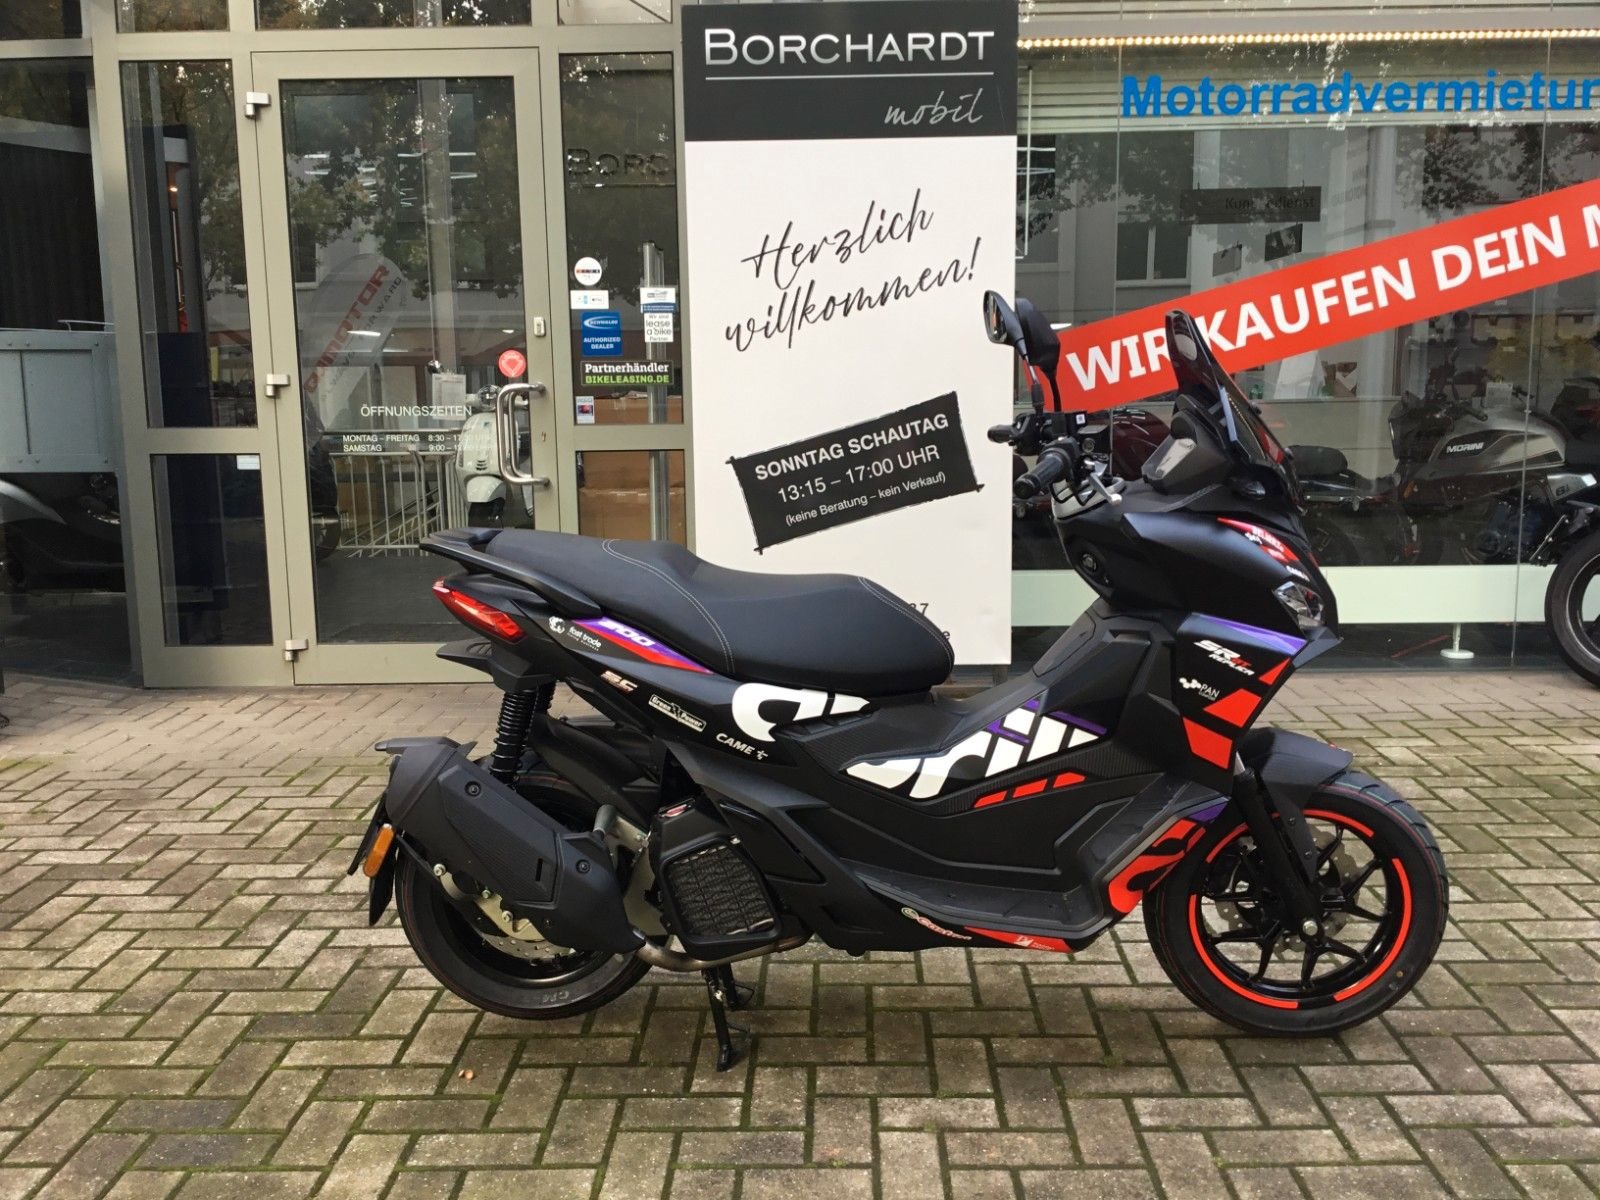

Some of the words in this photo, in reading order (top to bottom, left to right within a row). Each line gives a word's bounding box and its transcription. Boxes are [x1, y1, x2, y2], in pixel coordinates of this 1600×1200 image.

[704, 27, 995, 66] BORCHARDT
[884, 88, 984, 127] mobil
[741, 188, 935, 287] Herzlich
[725, 236, 982, 352] willkommen!
[1194, 258, 1416, 354] KAUFEN
[1431, 215, 1566, 292] DEIN
[584, 362, 670, 374] Partnerhändler
[585, 374, 670, 385] BIKELEASING.DE
[360, 403, 473, 417] ÖFFNUNGSZEITEN
[342, 434, 378, 442] MONTAG
[386, 434, 420, 442] FREITAG
[428, 434, 445, 442] 8:30
[343, 444, 383, 452] SAMSTAG
[754, 443, 845, 481] SONNTAG
[847, 413, 949, 455] SCHAUTAG
[1446, 441, 1485, 453] MORINI
[777, 476, 827, 504] 13:15
[845, 459, 895, 486] 17:00
[897, 444, 941, 470] UHR
[785, 507, 818, 527] (keine
[819, 493, 869, 516] Beratung
[878, 484, 902, 500] kein
[902, 470, 947, 493] Verkauf)
[582, 632, 603, 649] trade
[1199, 682, 1221, 699] PAN
[651, 696, 672, 712] Green
[680, 712, 703, 728] Power
[715, 732, 756, 755] CAME
